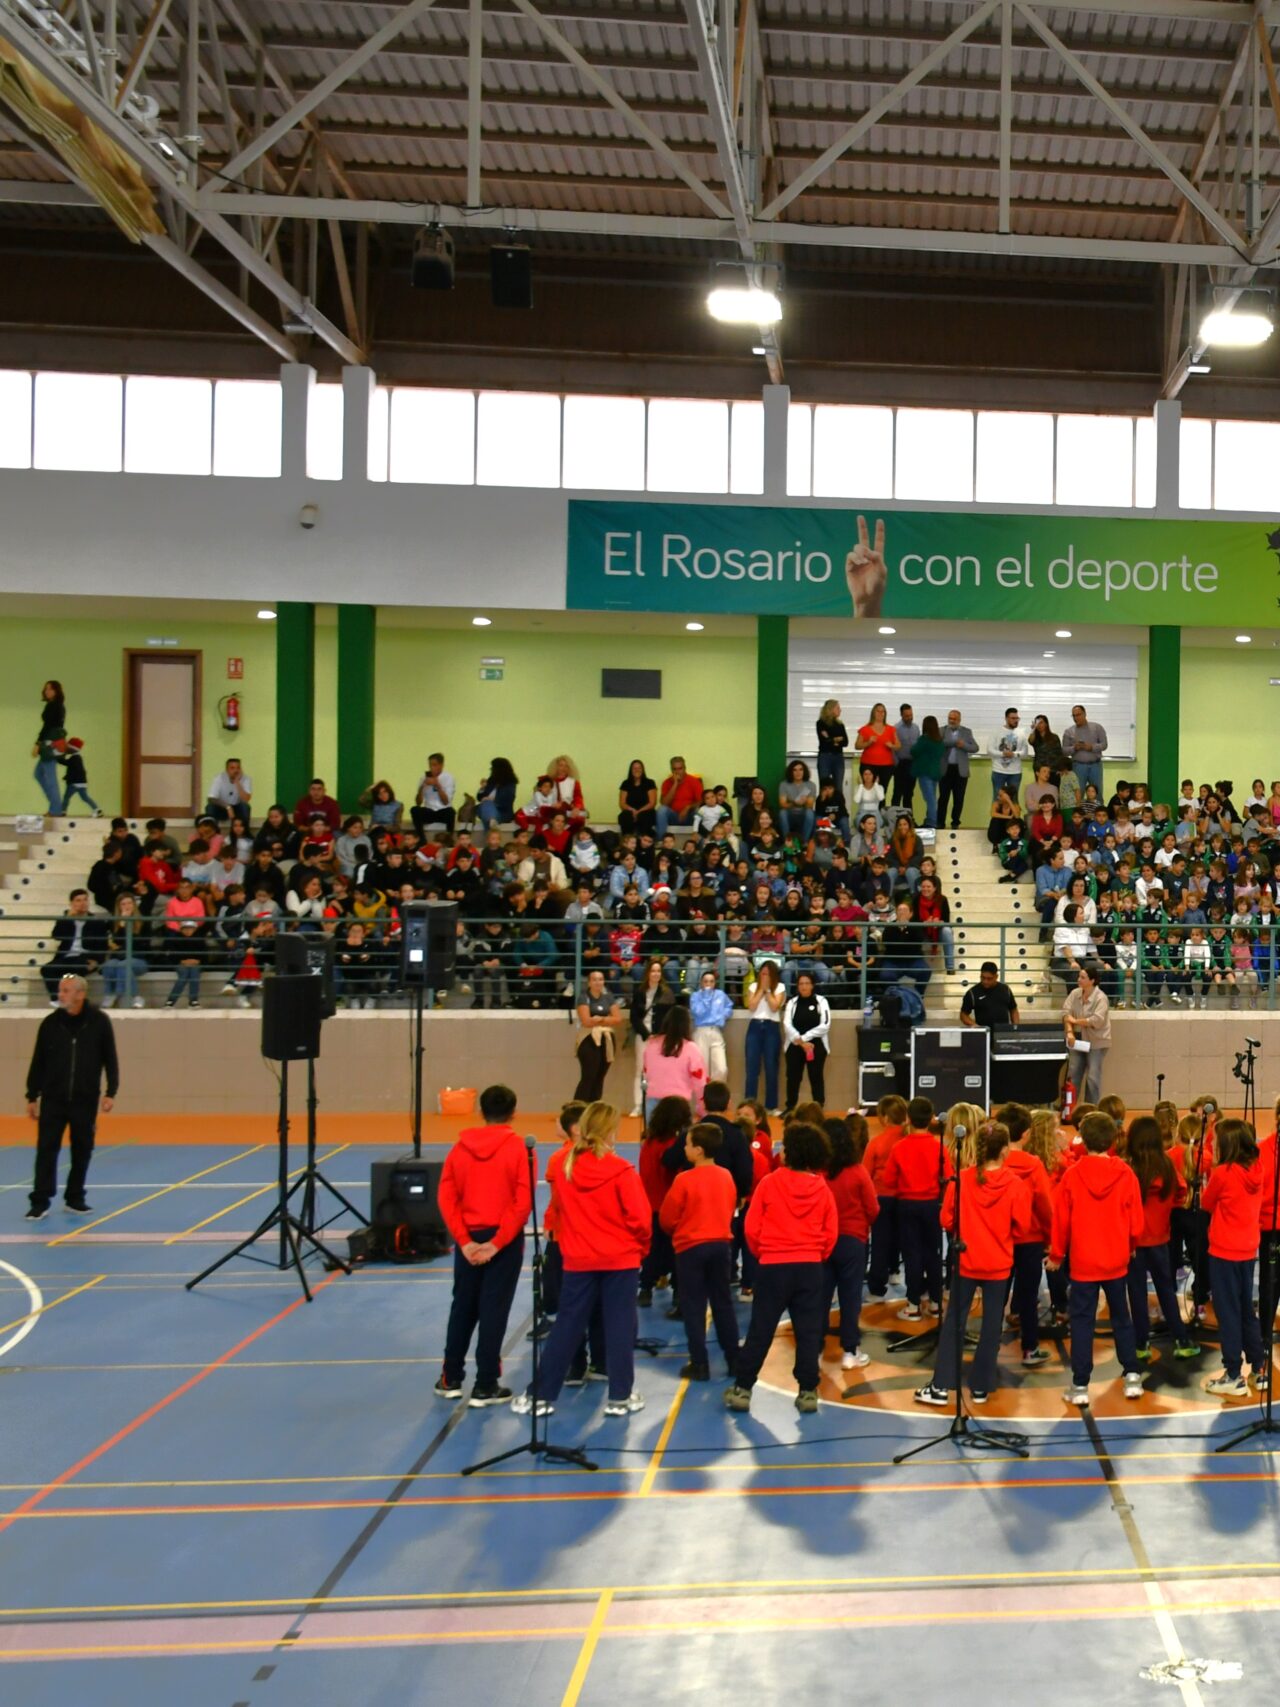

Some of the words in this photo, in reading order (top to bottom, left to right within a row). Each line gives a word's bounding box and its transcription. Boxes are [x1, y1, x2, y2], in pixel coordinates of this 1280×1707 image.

[604, 531, 645, 577] El
[662, 534, 832, 582] Rosario
[899, 554, 981, 586] con
[996, 543, 1034, 588] el
[1047, 545, 1219, 601] deporte
